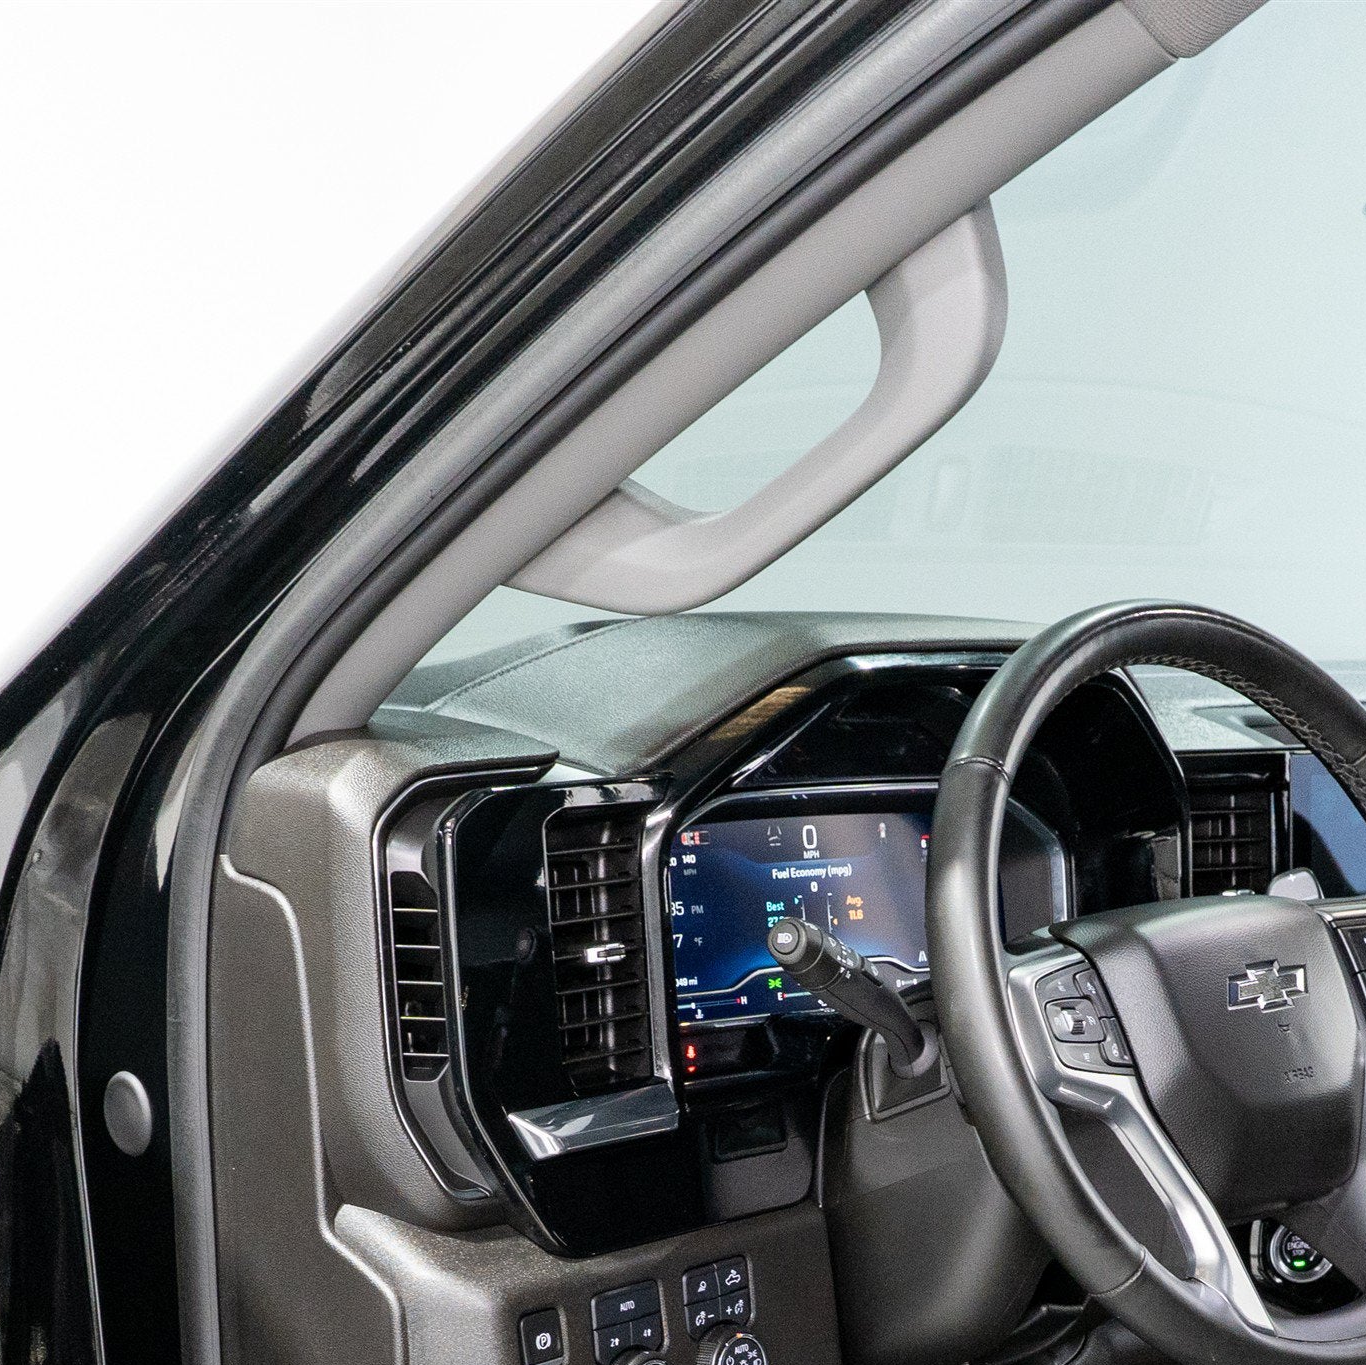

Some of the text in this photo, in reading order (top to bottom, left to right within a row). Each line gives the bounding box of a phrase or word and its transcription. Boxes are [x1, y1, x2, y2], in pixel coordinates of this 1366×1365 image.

[802, 824, 817, 849] 0
[803, 850, 820, 859] MPH
[772, 863, 852, 879] Fuel Economy (mpg)
[810, 881, 818, 892] 0
[670, 901, 704, 916] 35 PM
[766, 901, 785, 912] Best
[672, 933, 683, 948] 7
[688, 976, 698, 986] mi
[619, 1300, 635, 1312] AUTO
[734, 1343, 749, 1355] AUTO
